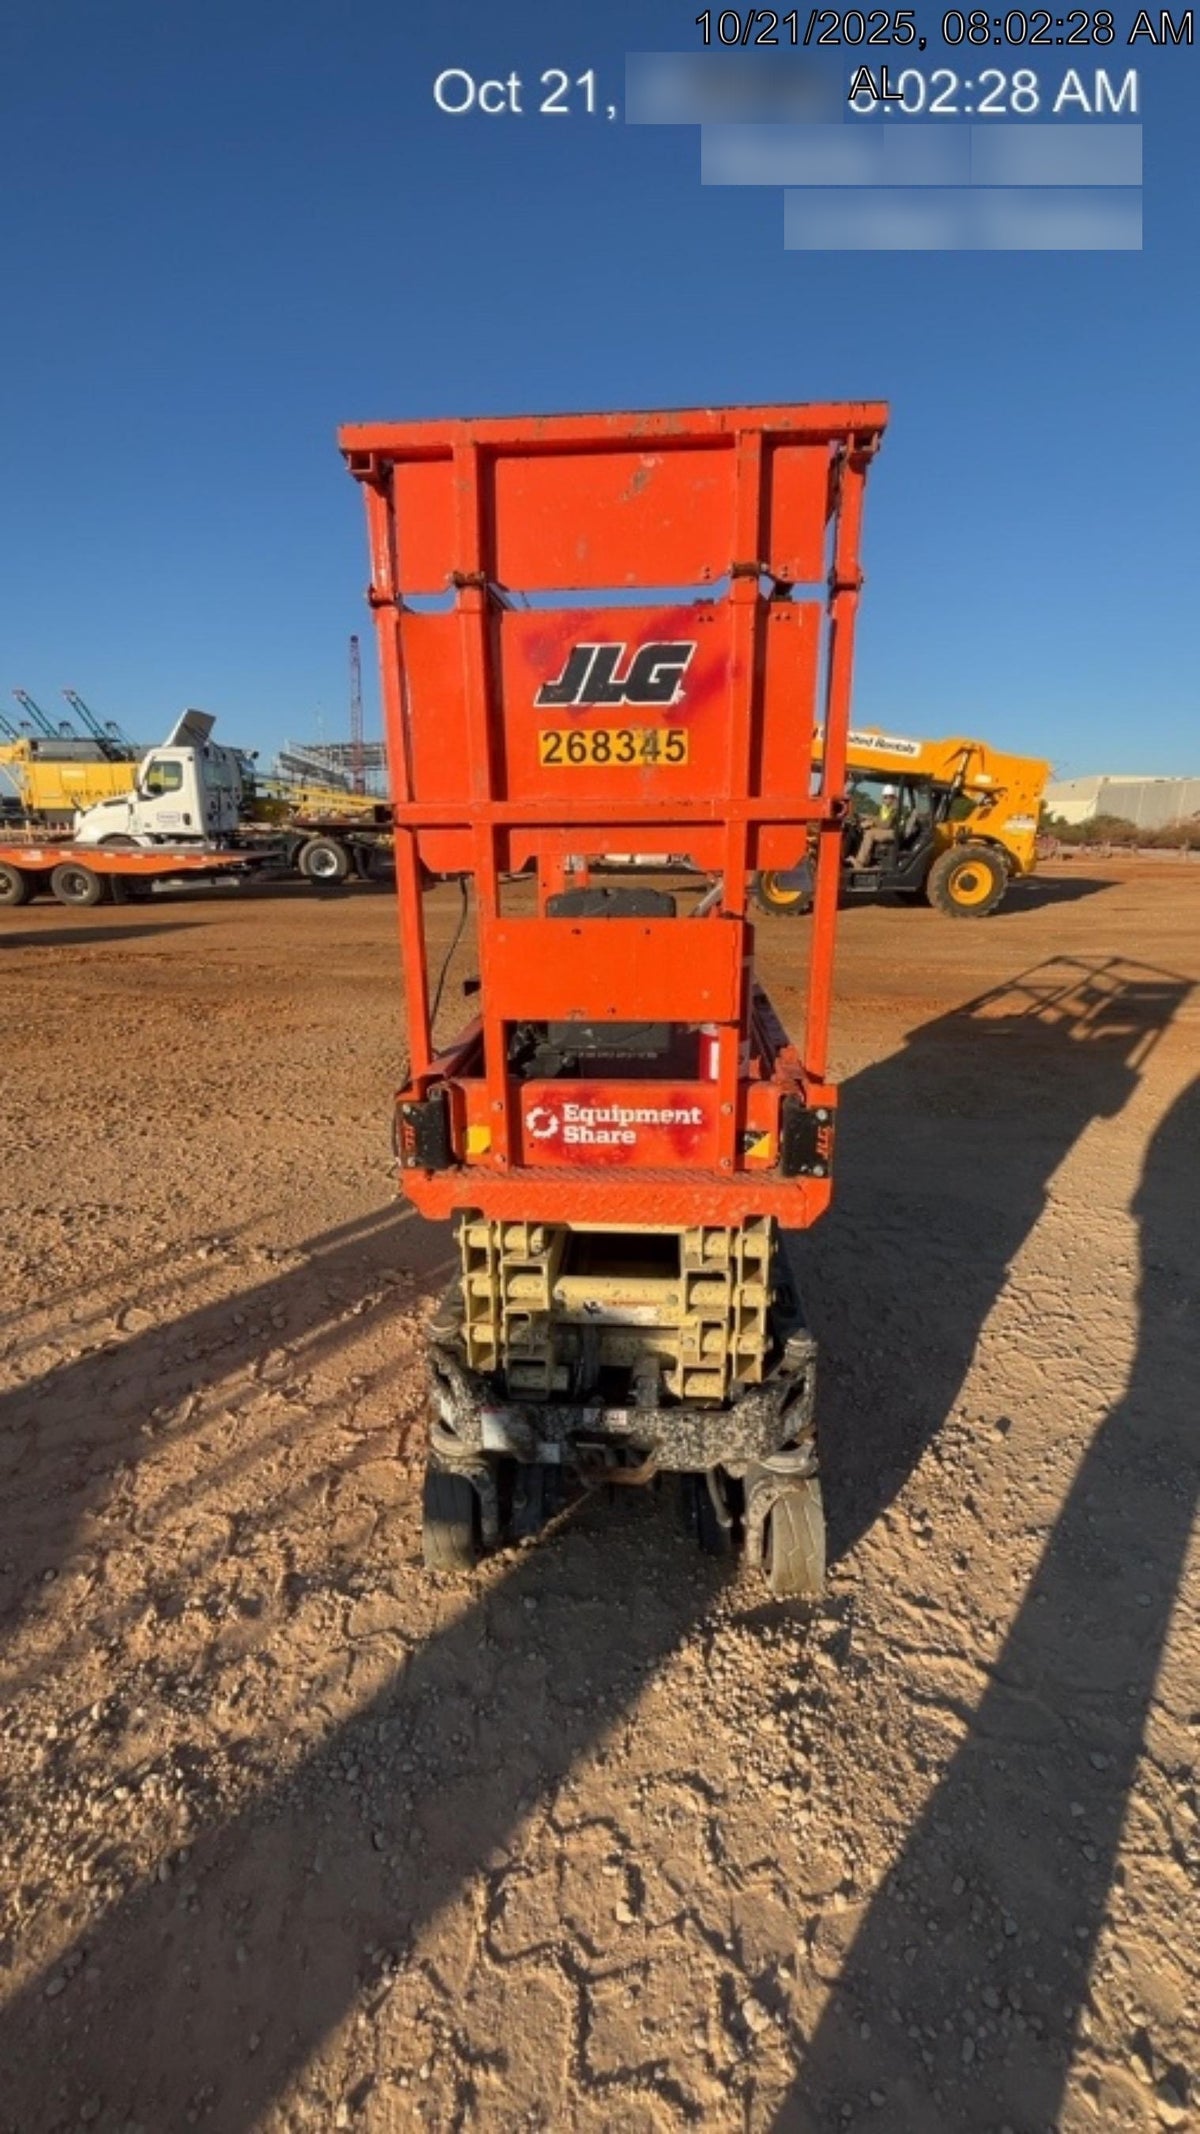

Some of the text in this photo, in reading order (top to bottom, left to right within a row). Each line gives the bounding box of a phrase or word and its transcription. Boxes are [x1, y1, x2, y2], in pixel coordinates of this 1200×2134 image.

[533, 641, 697, 707] JLG
[542, 730, 686, 764] 268345
[562, 1104, 702, 1126] Equipment
[563, 1125, 636, 1144] Share
